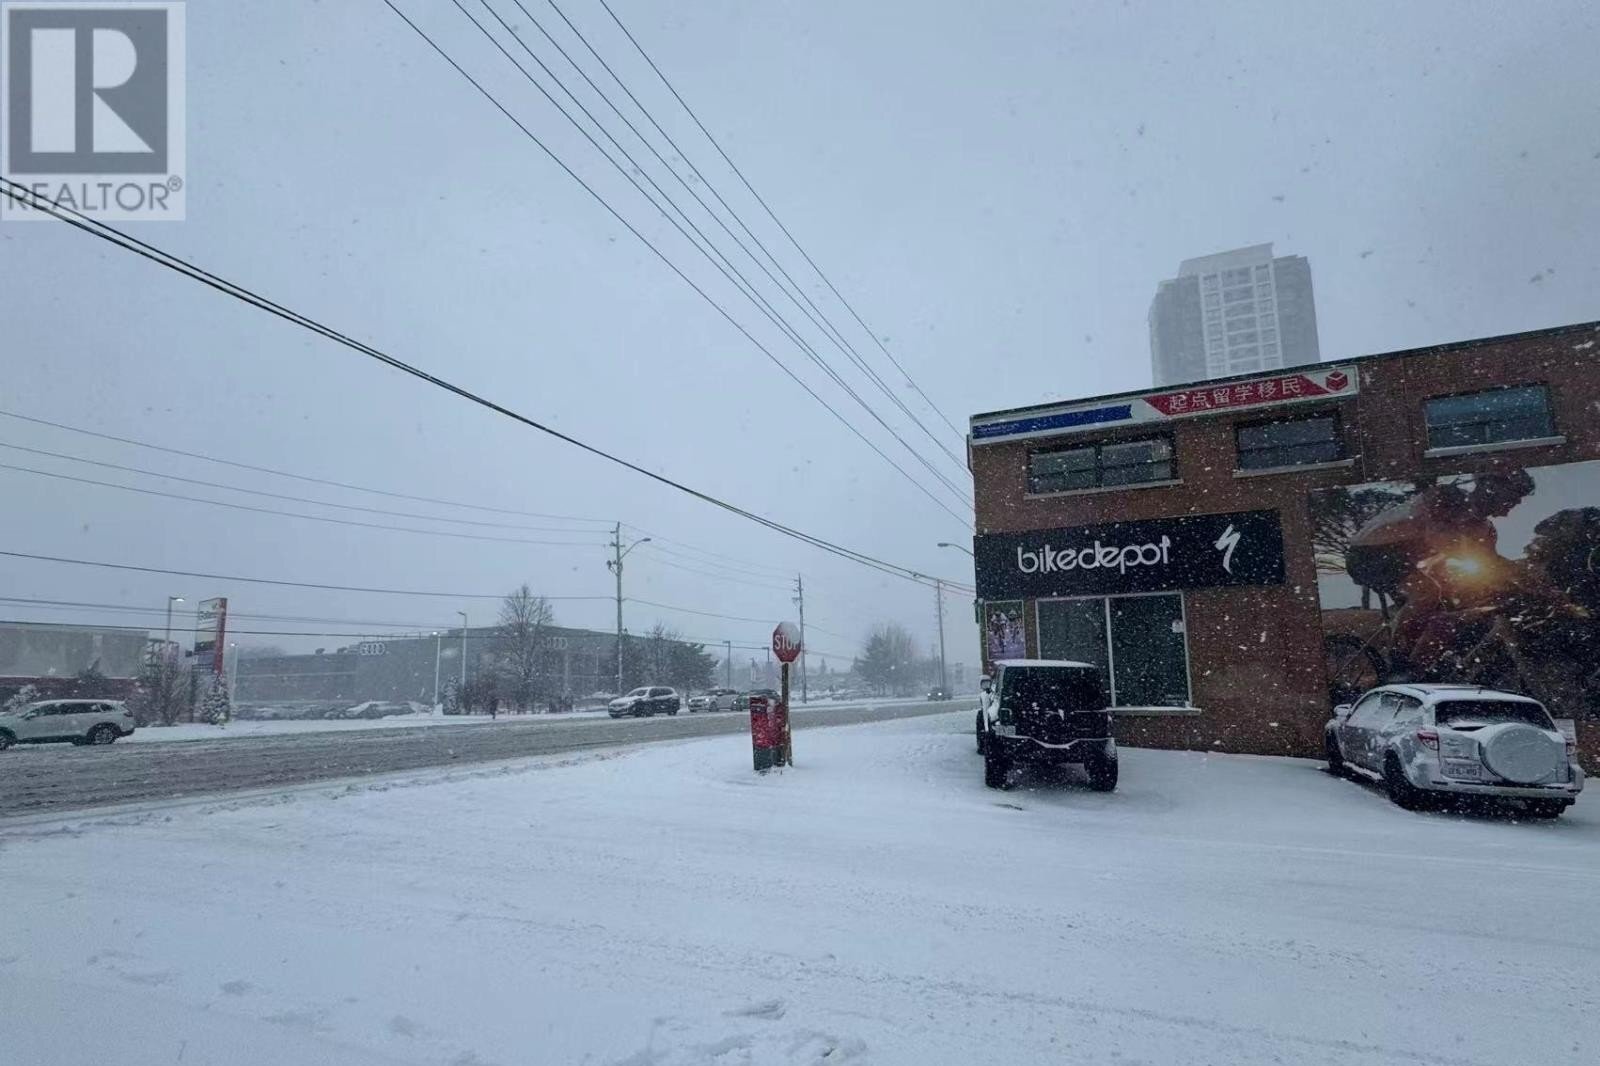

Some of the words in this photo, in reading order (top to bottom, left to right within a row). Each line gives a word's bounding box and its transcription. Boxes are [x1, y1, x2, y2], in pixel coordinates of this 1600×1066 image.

[1168, 377, 1301, 412] 起点留学移民
[1017, 534, 1171, 575] bikedepot
